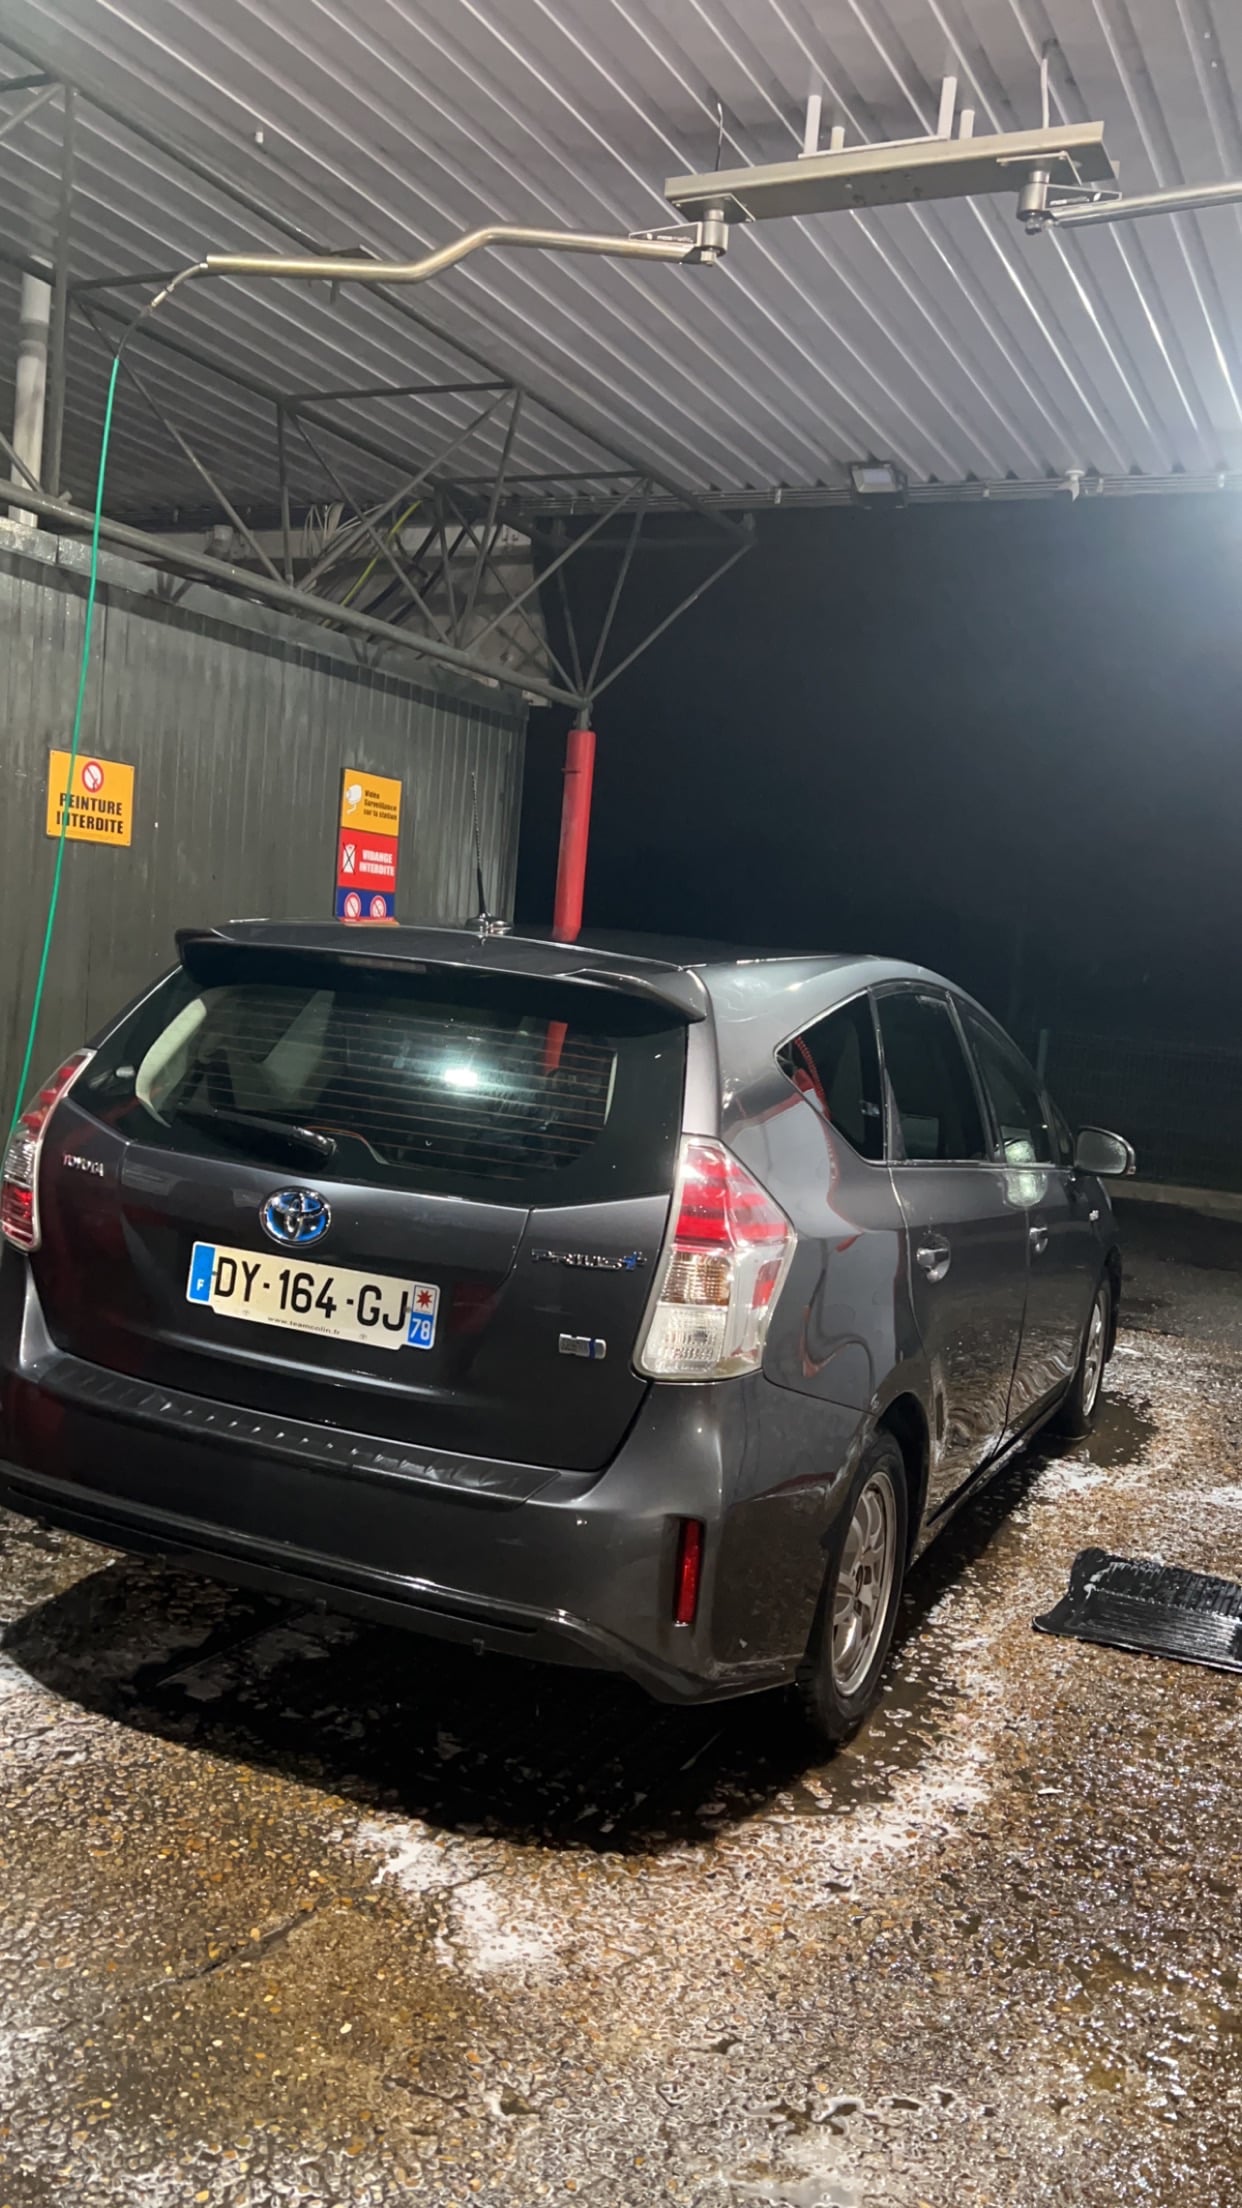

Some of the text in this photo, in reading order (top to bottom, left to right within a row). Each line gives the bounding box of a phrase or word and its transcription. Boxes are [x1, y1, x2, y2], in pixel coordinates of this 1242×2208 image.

[59, 792, 123, 816] PEINTURE
[362, 849, 393, 864] VIDANGE
[359, 861, 395, 877] INTERDITE
[63, 1154, 104, 1177] TOYOTA
[196, 1278, 205, 1291] F
[214, 1256, 409, 1331] DY-164-GJ
[410, 1318, 431, 1340] 78
